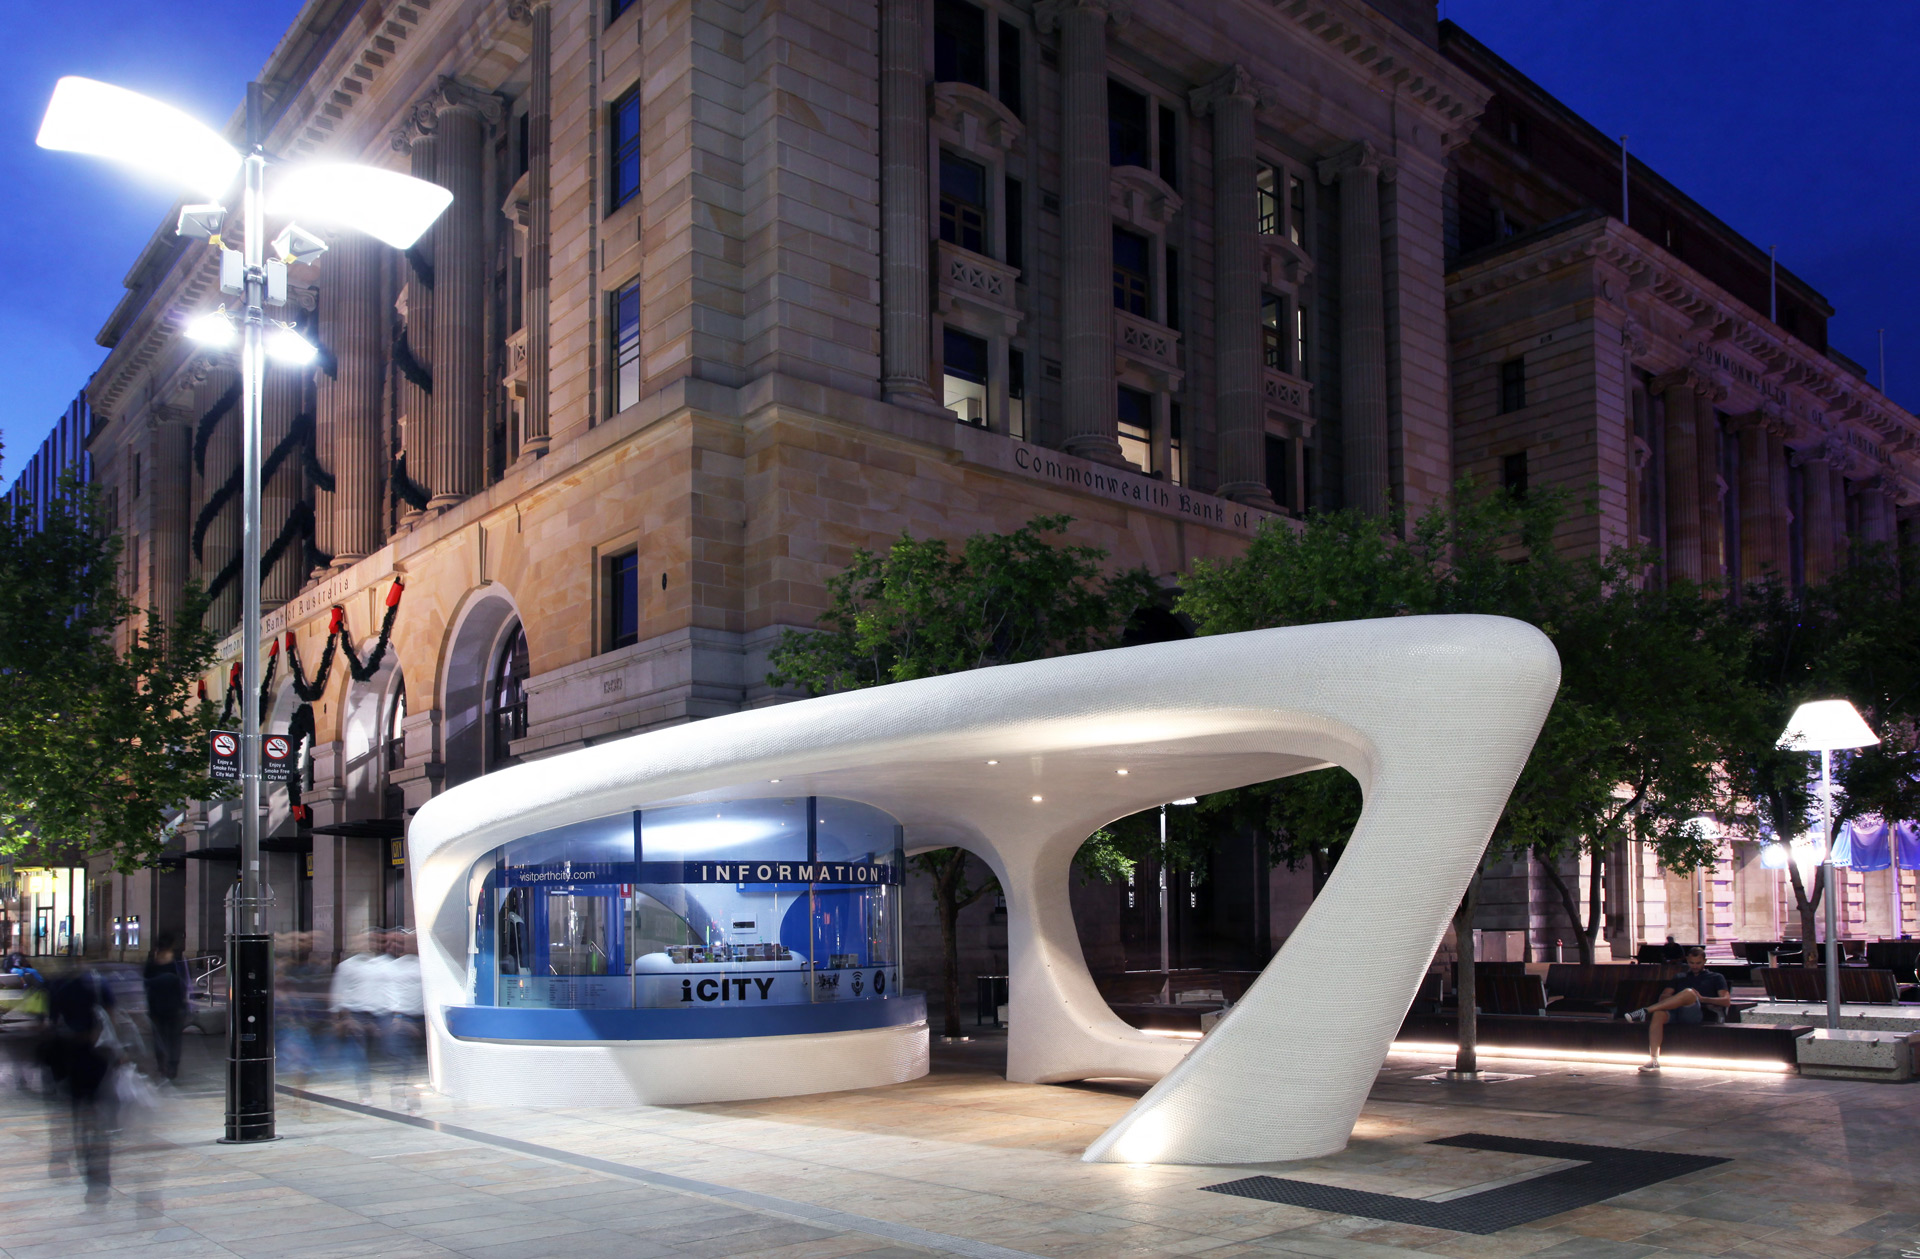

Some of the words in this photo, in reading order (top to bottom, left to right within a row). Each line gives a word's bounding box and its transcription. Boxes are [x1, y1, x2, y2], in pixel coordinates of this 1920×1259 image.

[1698, 341, 1786, 405] COMMONWEALTH
[1812, 409, 1822, 424] OF
[1015, 447, 1169, 507] Commonwealth
[1178, 492, 1223, 522] Bank
[1234, 512, 1247, 528] of
[266, 615, 284, 633] Bank
[299, 578, 349, 615] Australia
[519, 870, 596, 882] visitperthcity.com
[702, 864, 878, 882] INFORMATION
[680, 977, 775, 1002] iCITY
